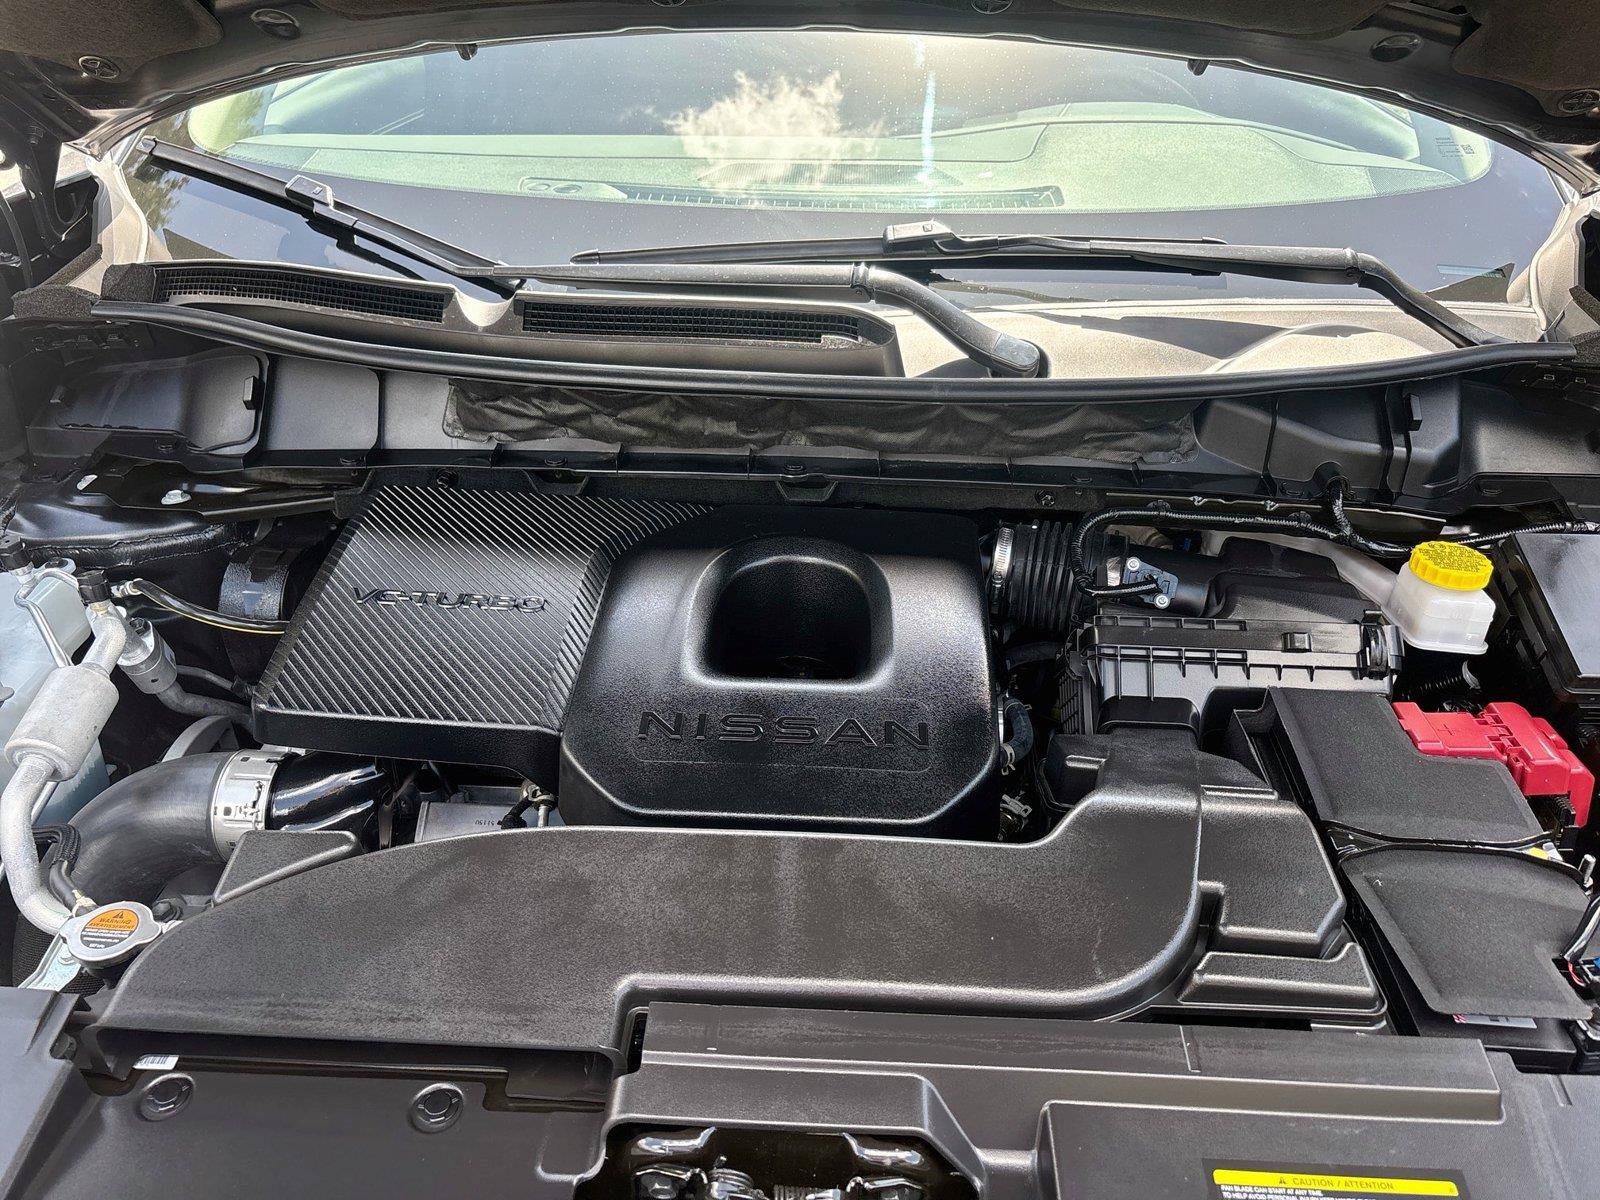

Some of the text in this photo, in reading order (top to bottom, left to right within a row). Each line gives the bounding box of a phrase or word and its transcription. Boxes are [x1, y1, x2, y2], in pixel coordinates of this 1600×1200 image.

[637, 711, 930, 749] NISSAN
[1292, 1178, 1334, 1188] CAUTION
[1344, 1180, 1395, 1190] ATTENTION
